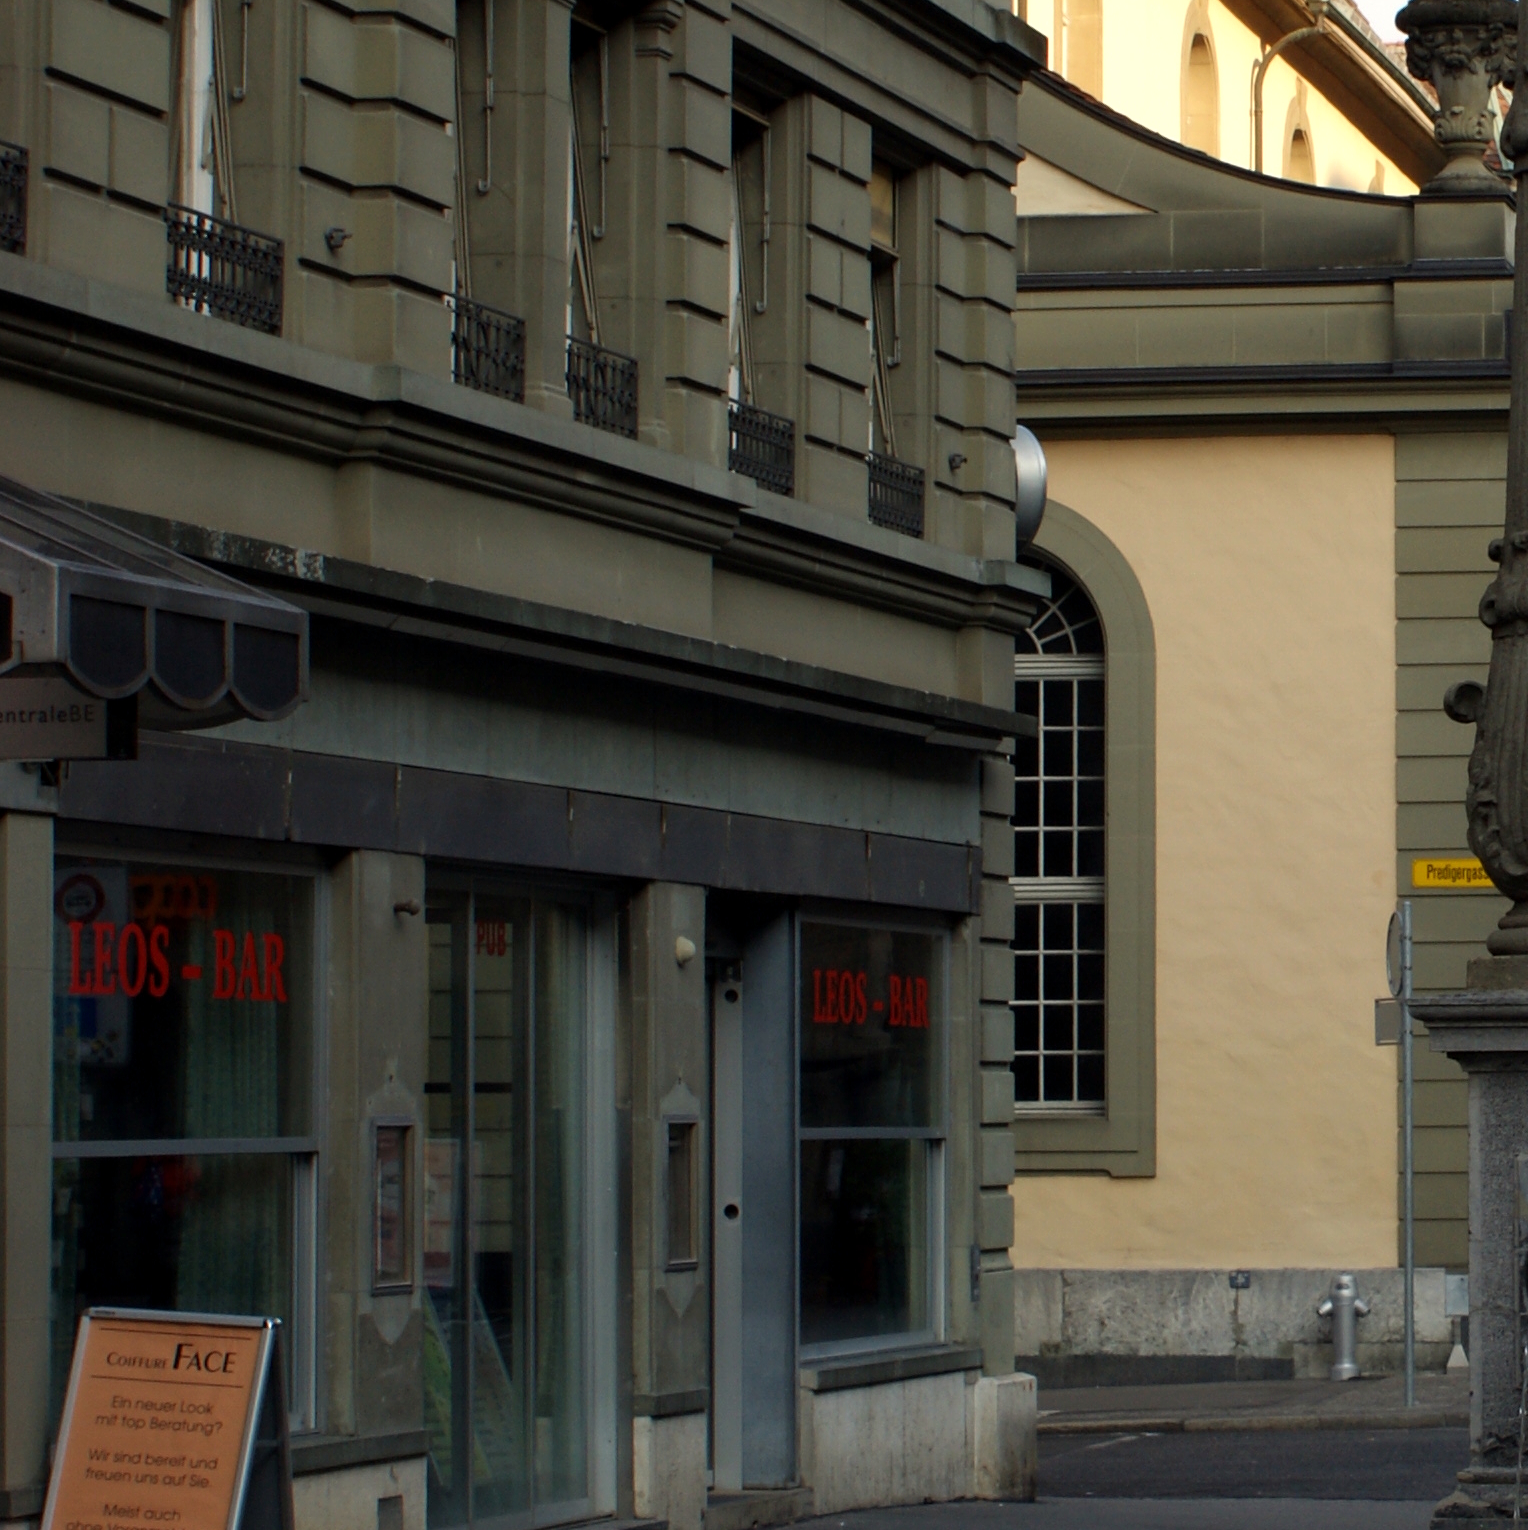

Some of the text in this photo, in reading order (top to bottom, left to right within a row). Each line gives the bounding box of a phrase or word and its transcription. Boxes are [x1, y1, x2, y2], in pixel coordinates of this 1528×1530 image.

[477, 917, 506, 956] PUB
[68, 921, 170, 997] LEOS
[213, 928, 288, 1003] BAR
[812, 968, 867, 1025] LEOS
[888, 973, 930, 1029] BAR
[173, 1343, 237, 1374] FACE
[110, 1395, 214, 1415] Ein neuer Look
[95, 1413, 223, 1436] mit top Beratung?
[88, 1448, 218, 1470] Wir sind bereit und
[86, 1468, 131, 1482] freuen
[134, 1474, 158, 1485] uns
[163, 1474, 186, 1487] auf
[102, 1503, 181, 1521] Meist auch
